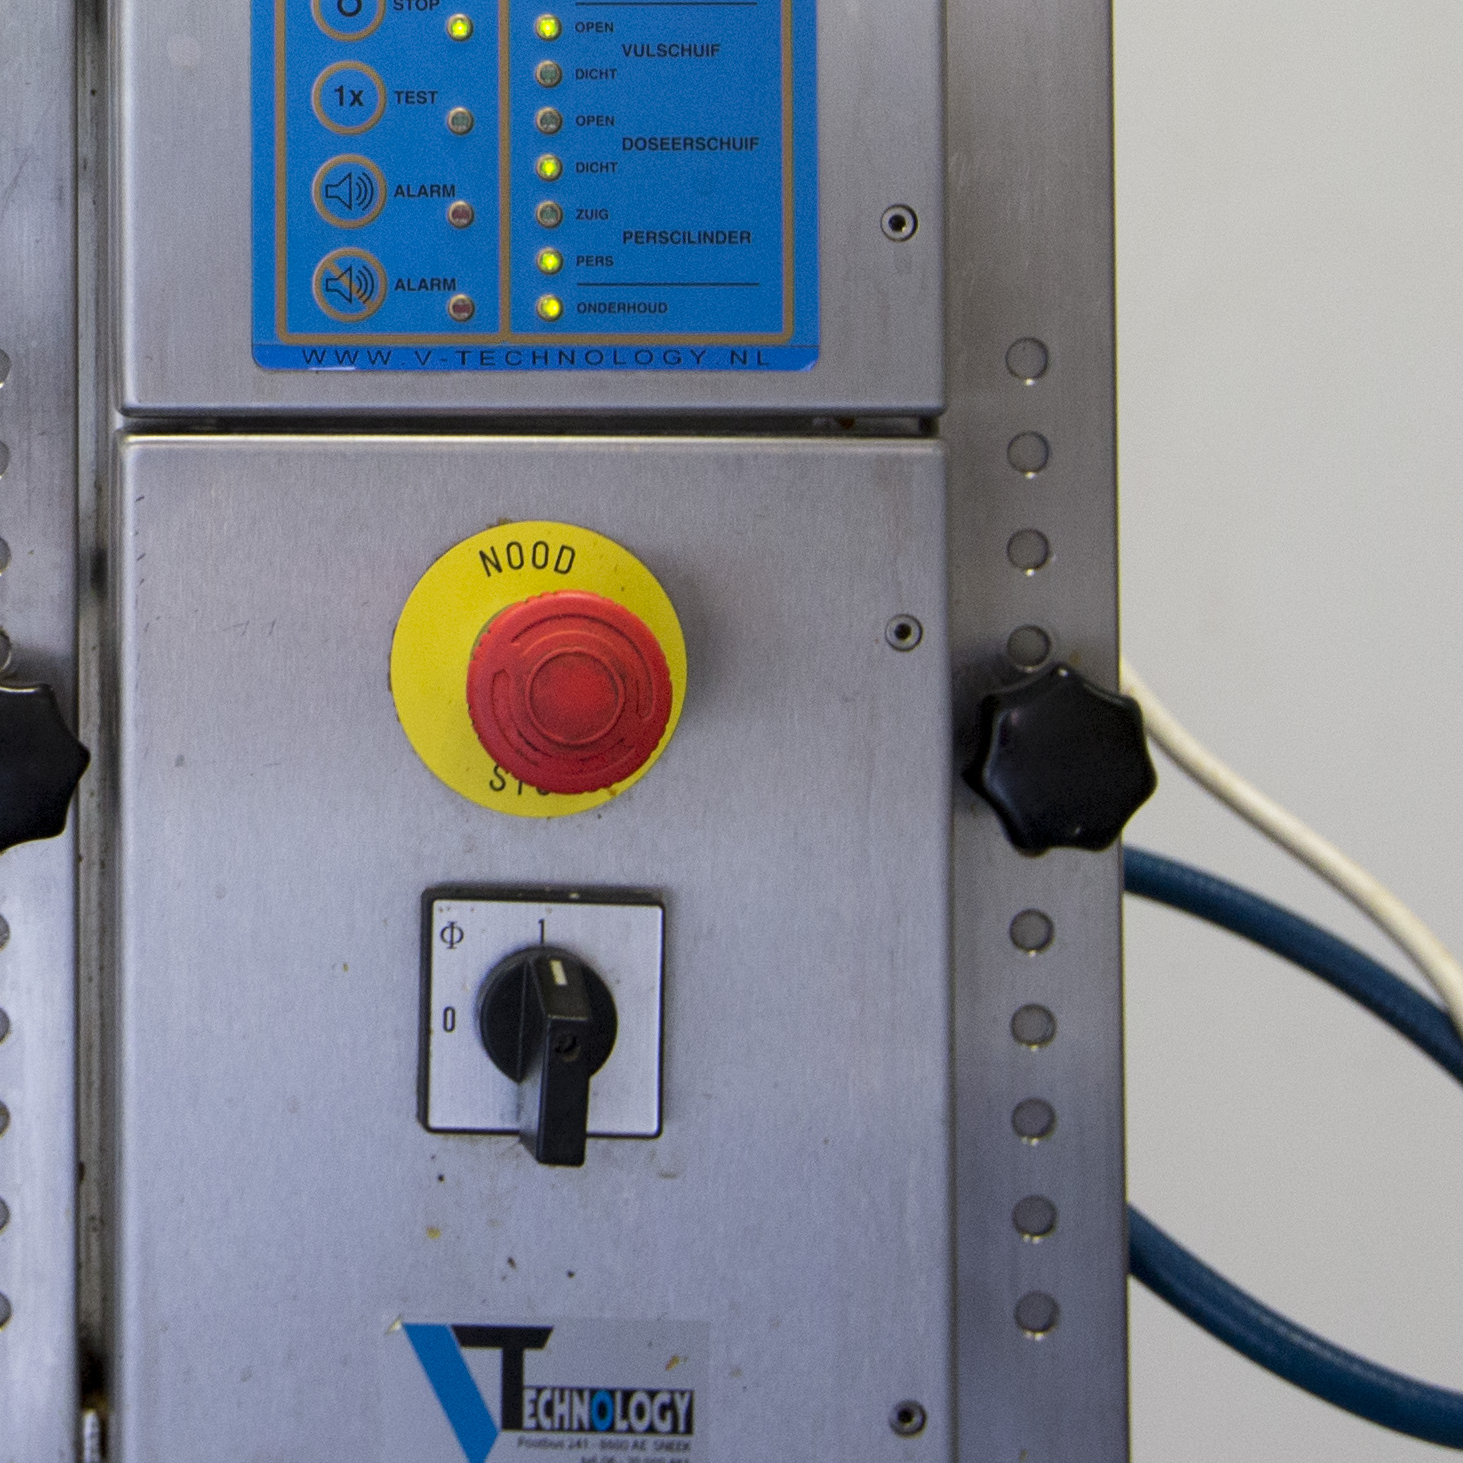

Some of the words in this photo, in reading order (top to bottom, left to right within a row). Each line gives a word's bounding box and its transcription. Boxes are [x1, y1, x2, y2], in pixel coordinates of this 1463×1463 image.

[575, 21, 613, 33] OPEN
[621, 43, 720, 58] VULSCHUIF
[575, 68, 617, 80] DICHT
[394, 90, 437, 105] TEST
[575, 114, 614, 127] OPEN
[622, 136, 759, 151] DOSEERSCHUIF
[575, 161, 617, 174] DICHT
[393, 184, 455, 198] ALARM
[576, 208, 609, 221] ZUIG
[622, 230, 751, 245] PERSCILINDER
[576, 255, 613, 267] PERS
[394, 277, 456, 292] ALARM
[577, 301, 668, 313] ONDERHOUD
[302, 349, 770, 367] WWW.V-TECHNOLOGY.NL
[479, 541, 575, 577] NOOD
